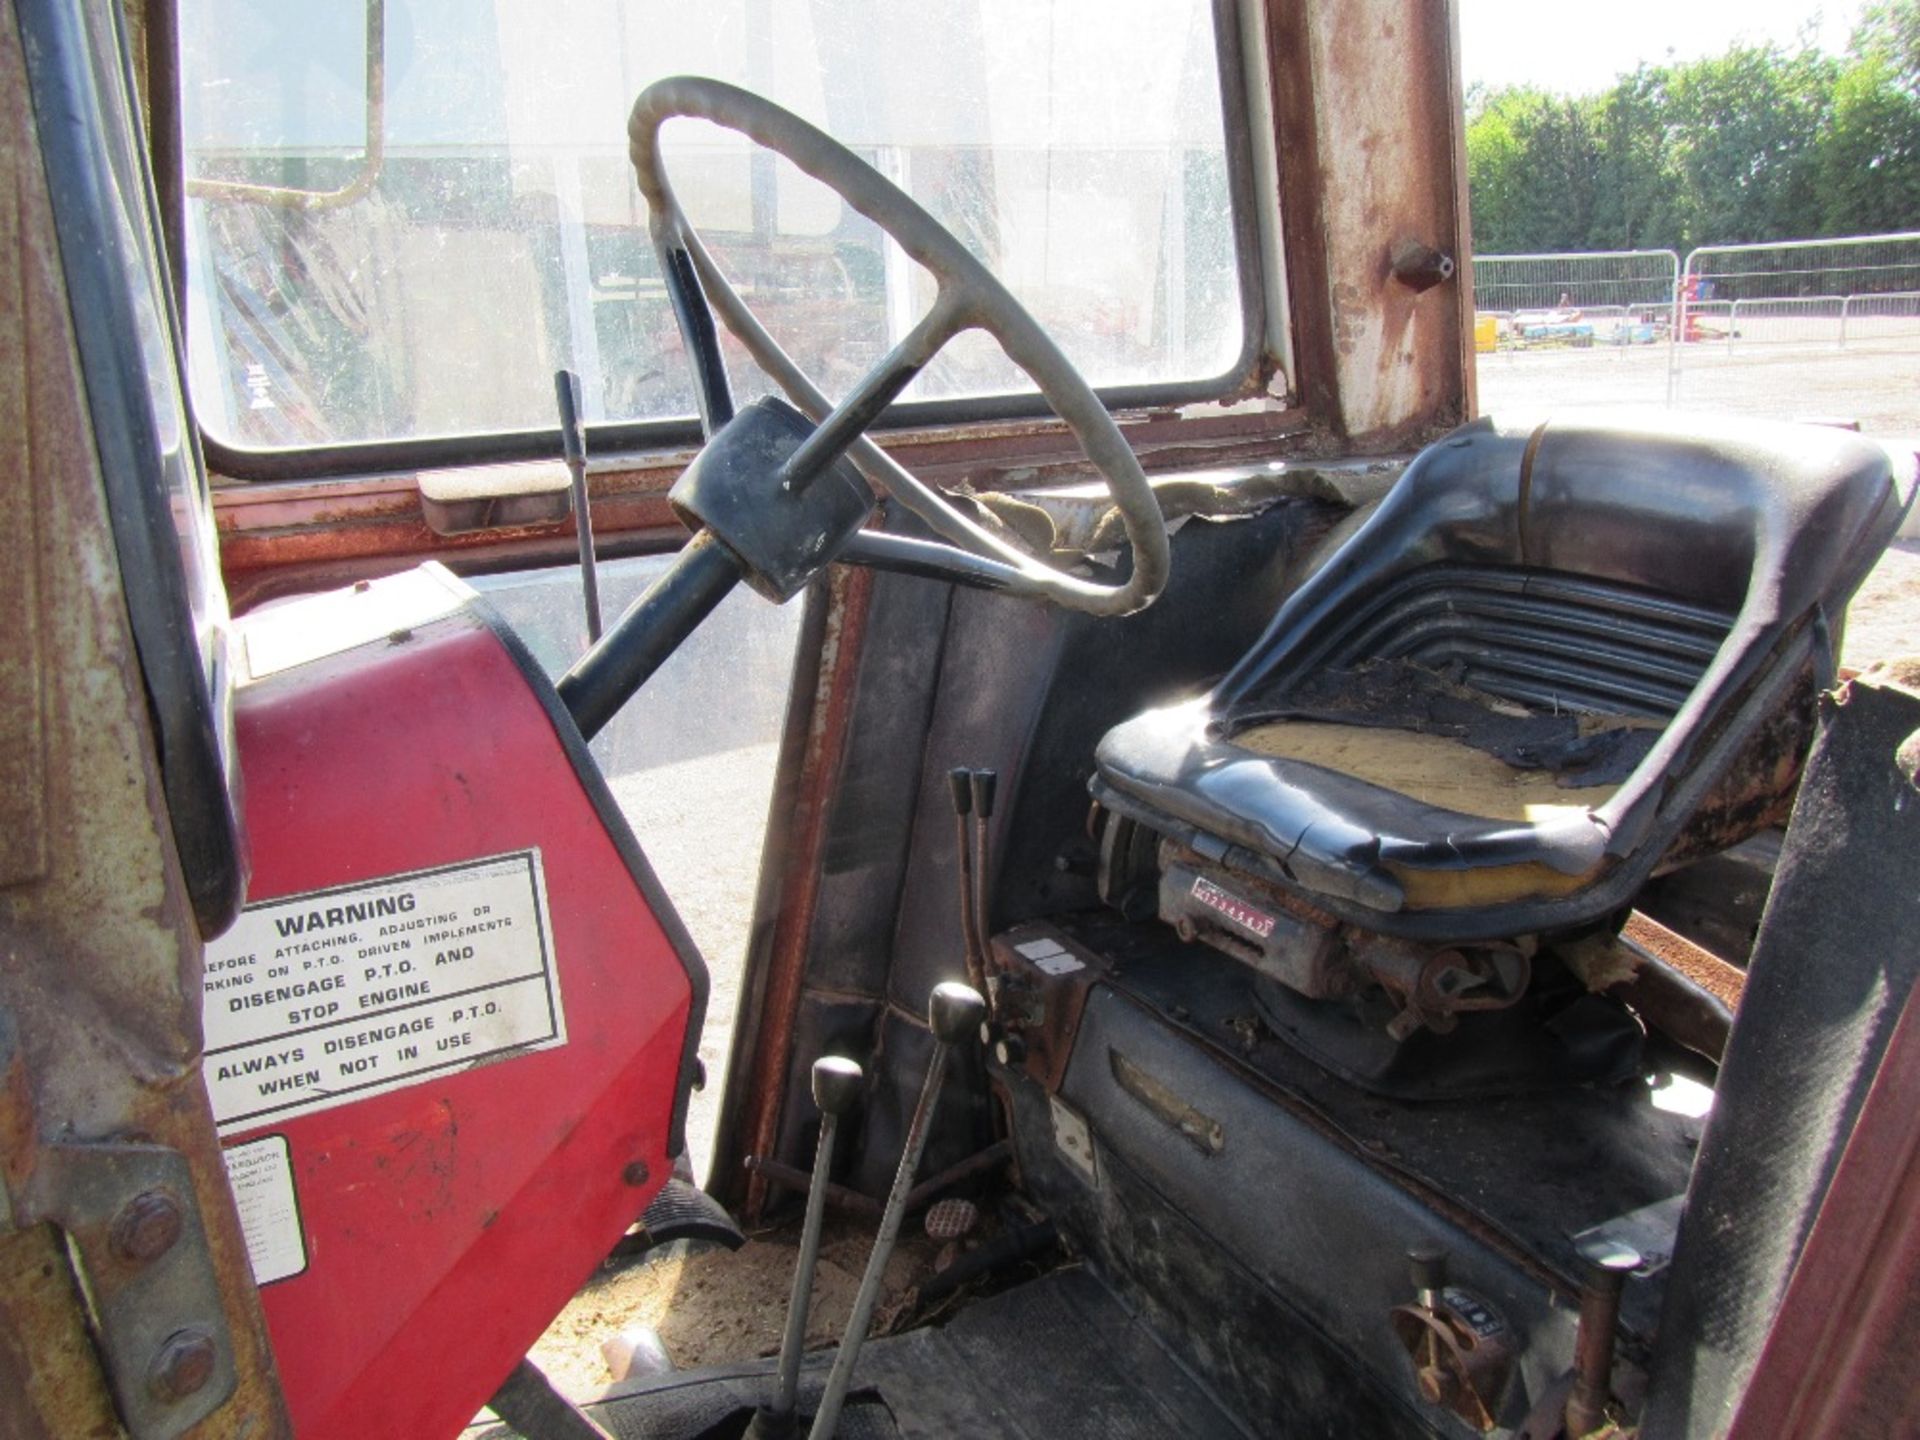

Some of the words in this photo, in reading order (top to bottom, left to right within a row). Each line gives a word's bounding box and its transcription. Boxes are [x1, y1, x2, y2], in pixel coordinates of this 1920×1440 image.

[275, 893, 416, 938] WARNING
[379, 911, 458, 937] ADJUSTING
[473, 905, 491, 917] OR
[204, 973, 254, 993] RKING
[268, 965, 289, 979] ON
[302, 954, 345, 970] P.T.O.
[358, 938, 411, 959] DRIVEN
[424, 917, 512, 944] IMPLEMENTS
[229, 974, 346, 1013] DISENGAGE
[364, 959, 417, 982] P.T.O.
[435, 946, 475, 966] AND
[288, 1001, 340, 1024] STOP
[358, 980, 431, 1009] ENGINE
[217, 1048, 305, 1081] ALWAYS
[323, 1017, 435, 1055] DISENGAGE
[258, 1069, 321, 1096] WHEN
[338, 1055, 379, 1076] NOT
[397, 1045, 418, 1061] IN
[436, 1032, 472, 1051] USE
